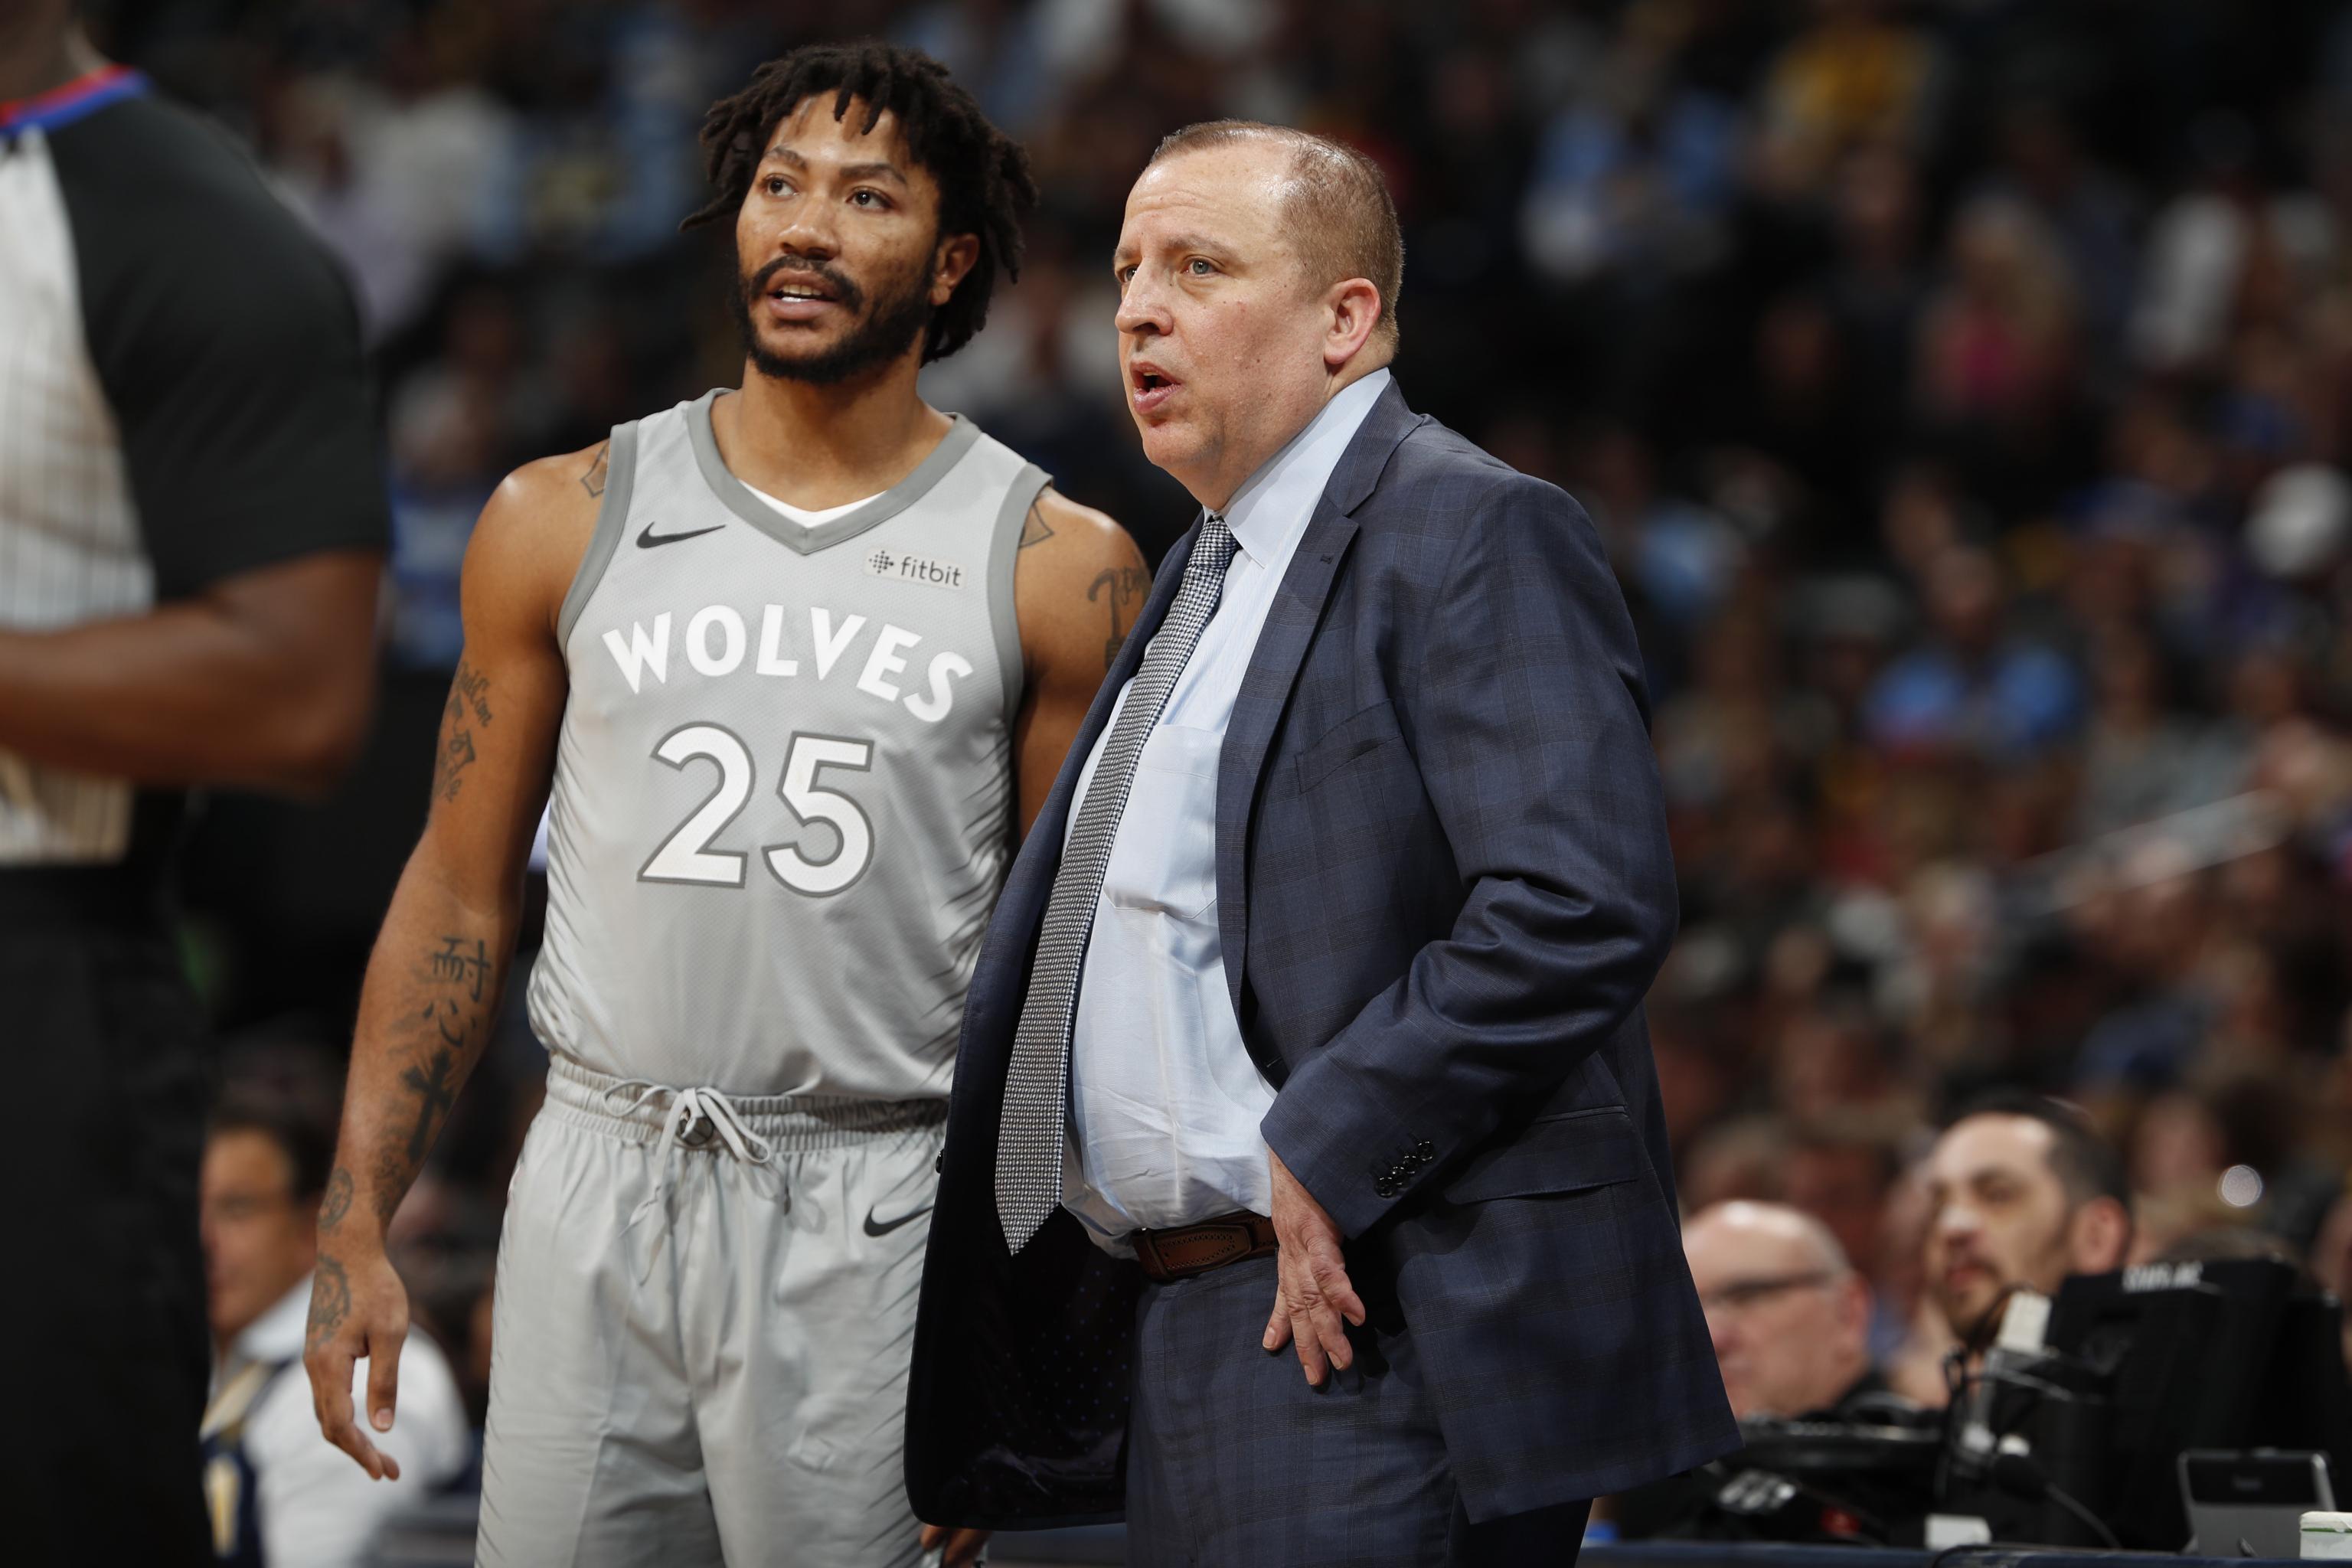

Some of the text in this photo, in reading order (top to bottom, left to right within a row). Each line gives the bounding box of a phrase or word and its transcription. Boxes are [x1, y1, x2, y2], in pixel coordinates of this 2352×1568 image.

[900, 556, 962, 586] fitbit
[602, 603, 973, 722] WOLVES
[636, 721, 874, 898] 25
